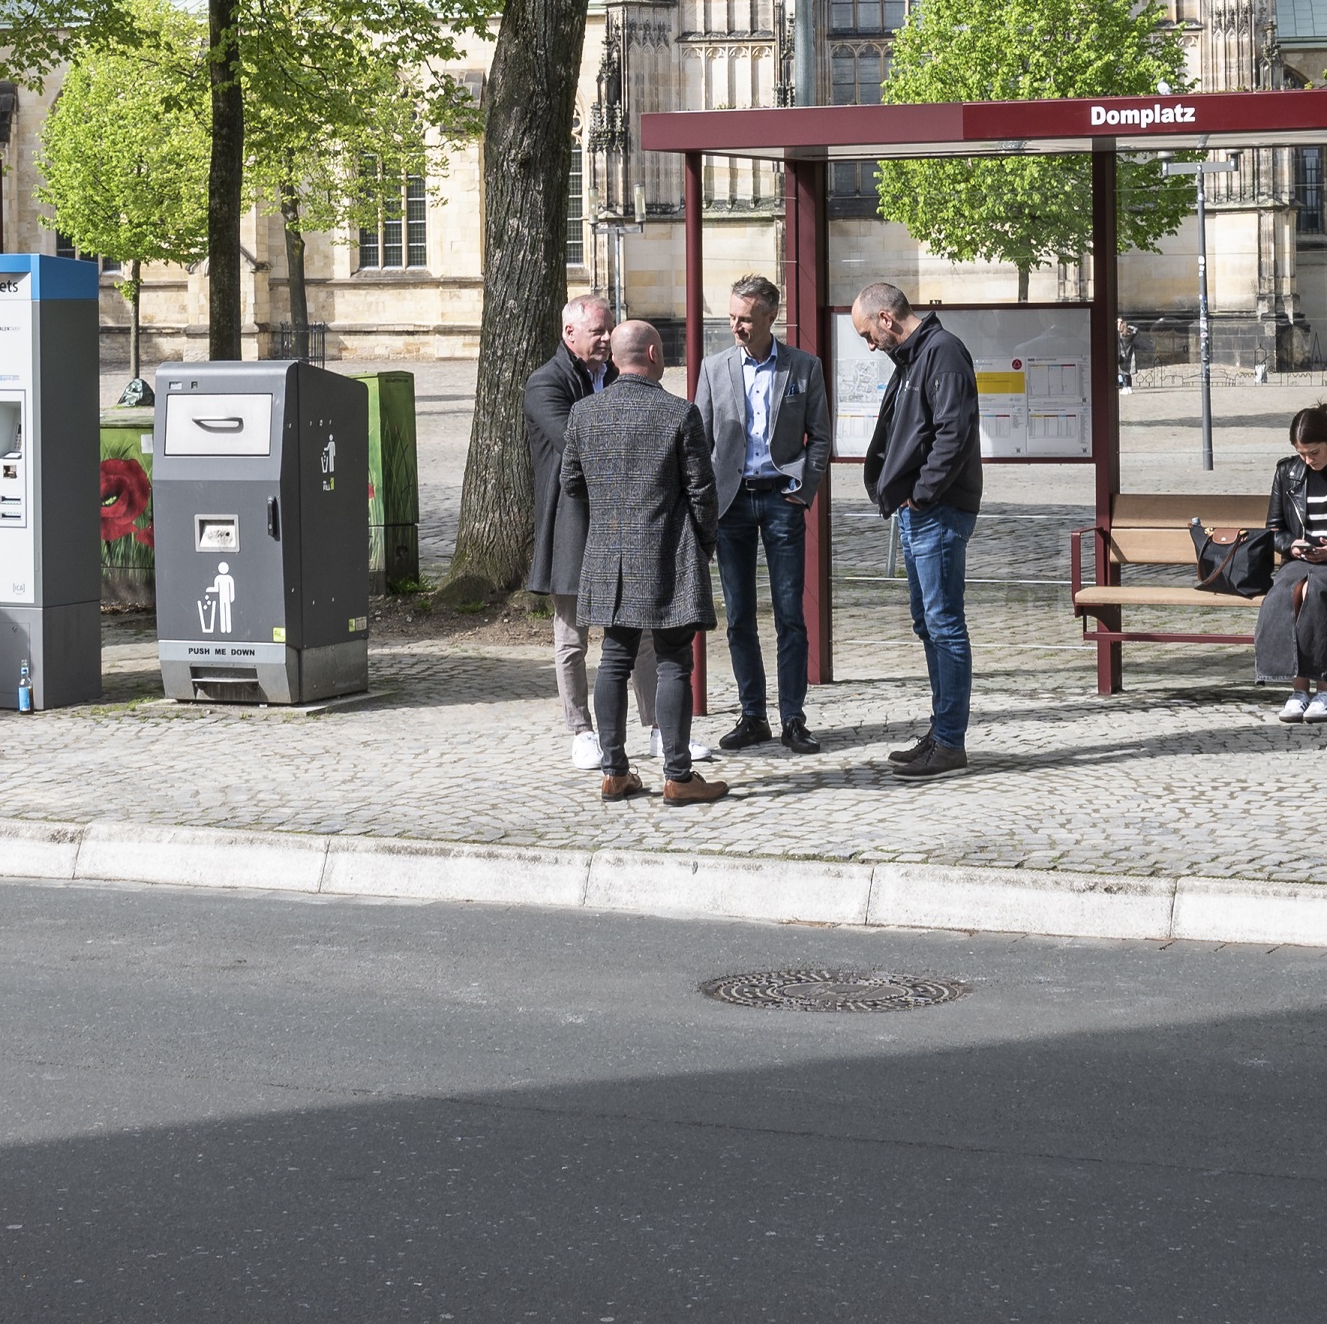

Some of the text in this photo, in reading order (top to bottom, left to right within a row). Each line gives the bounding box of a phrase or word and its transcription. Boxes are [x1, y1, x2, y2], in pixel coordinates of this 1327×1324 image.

[1090, 103, 1196, 129] Domplatz
[188, 647, 210, 655] PUSH
[230, 648, 255, 656] DOWN
